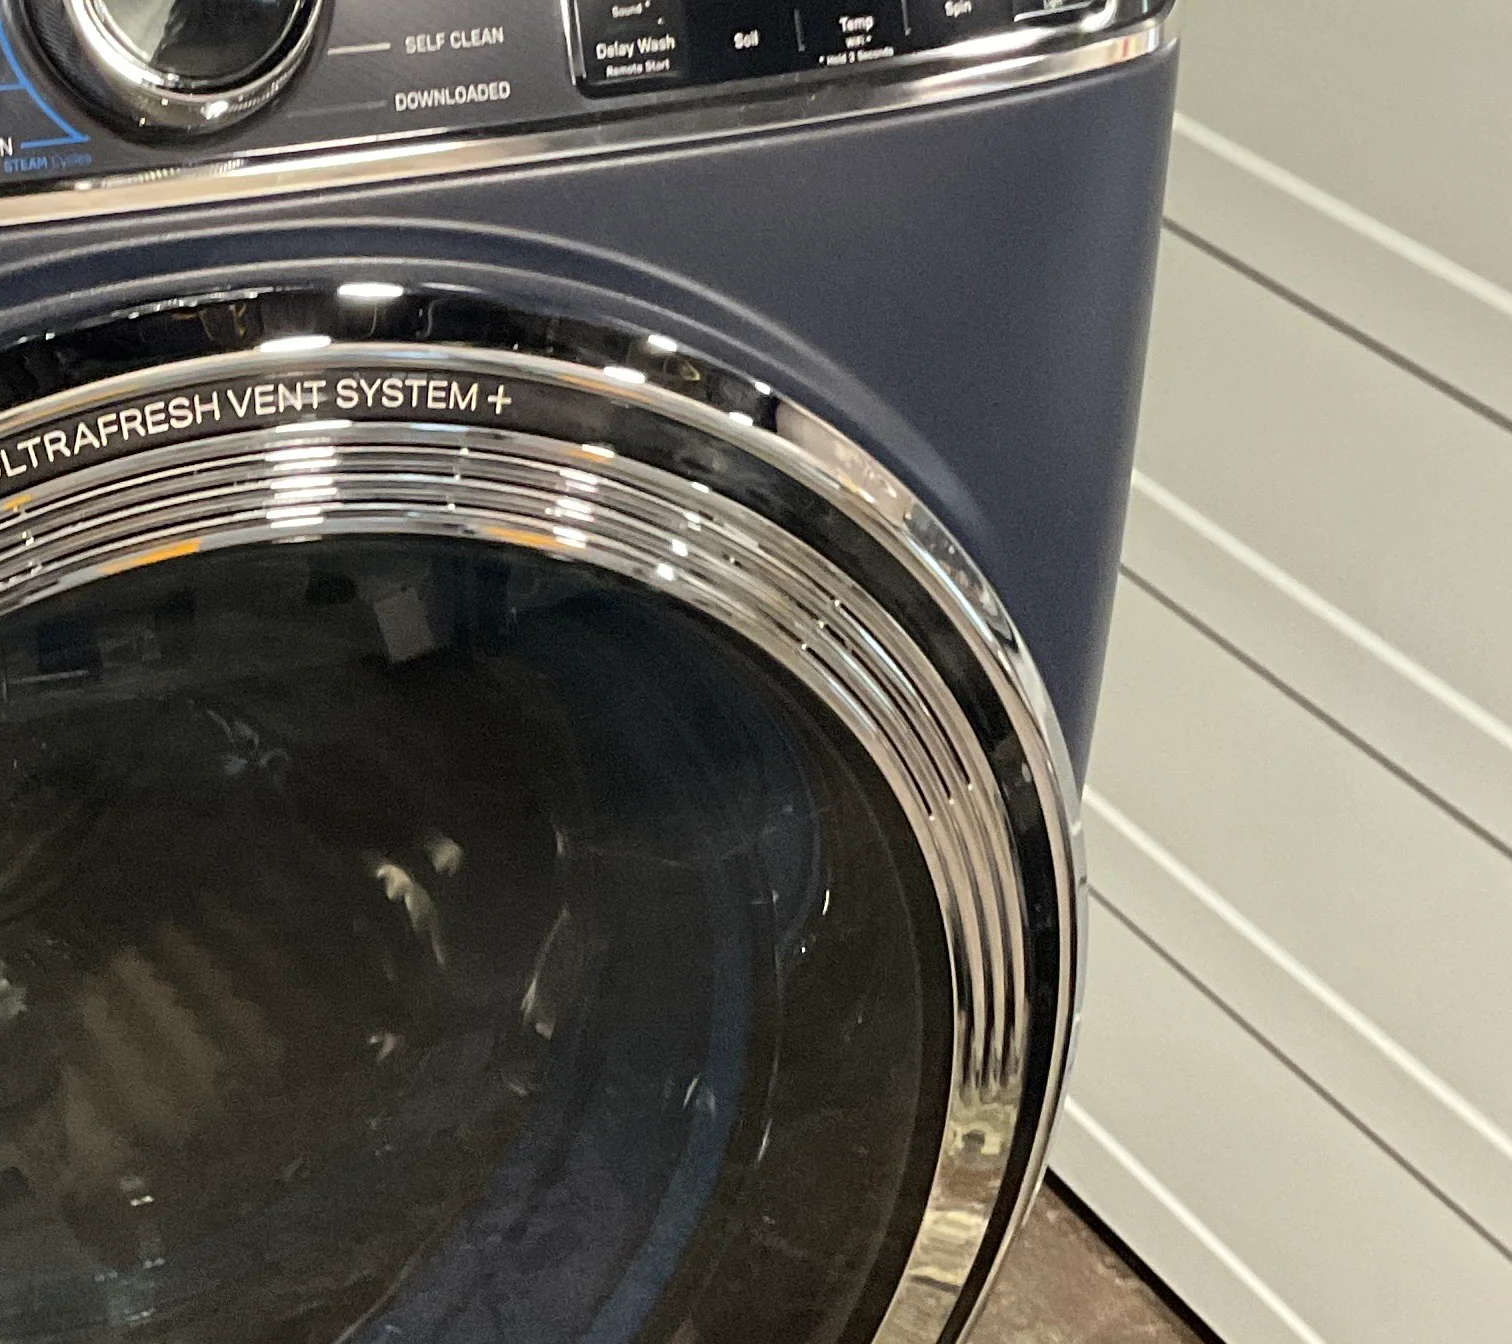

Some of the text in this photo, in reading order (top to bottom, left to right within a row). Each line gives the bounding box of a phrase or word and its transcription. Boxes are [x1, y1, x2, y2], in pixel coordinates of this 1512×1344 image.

[944, 0, 973, 18] Spin
[839, 14, 876, 33] Temp
[404, 26, 505, 55] SELF CLEAN
[596, 34, 675, 60] Delay Wash
[733, 29, 761, 50] Soil
[395, 80, 512, 112] DOWNLOADED
[3, 156, 48, 174] STEAM
[223, 379, 327, 418] VENT
[335, 377, 479, 413] SYSTEM
[487, 384, 513, 416] +
